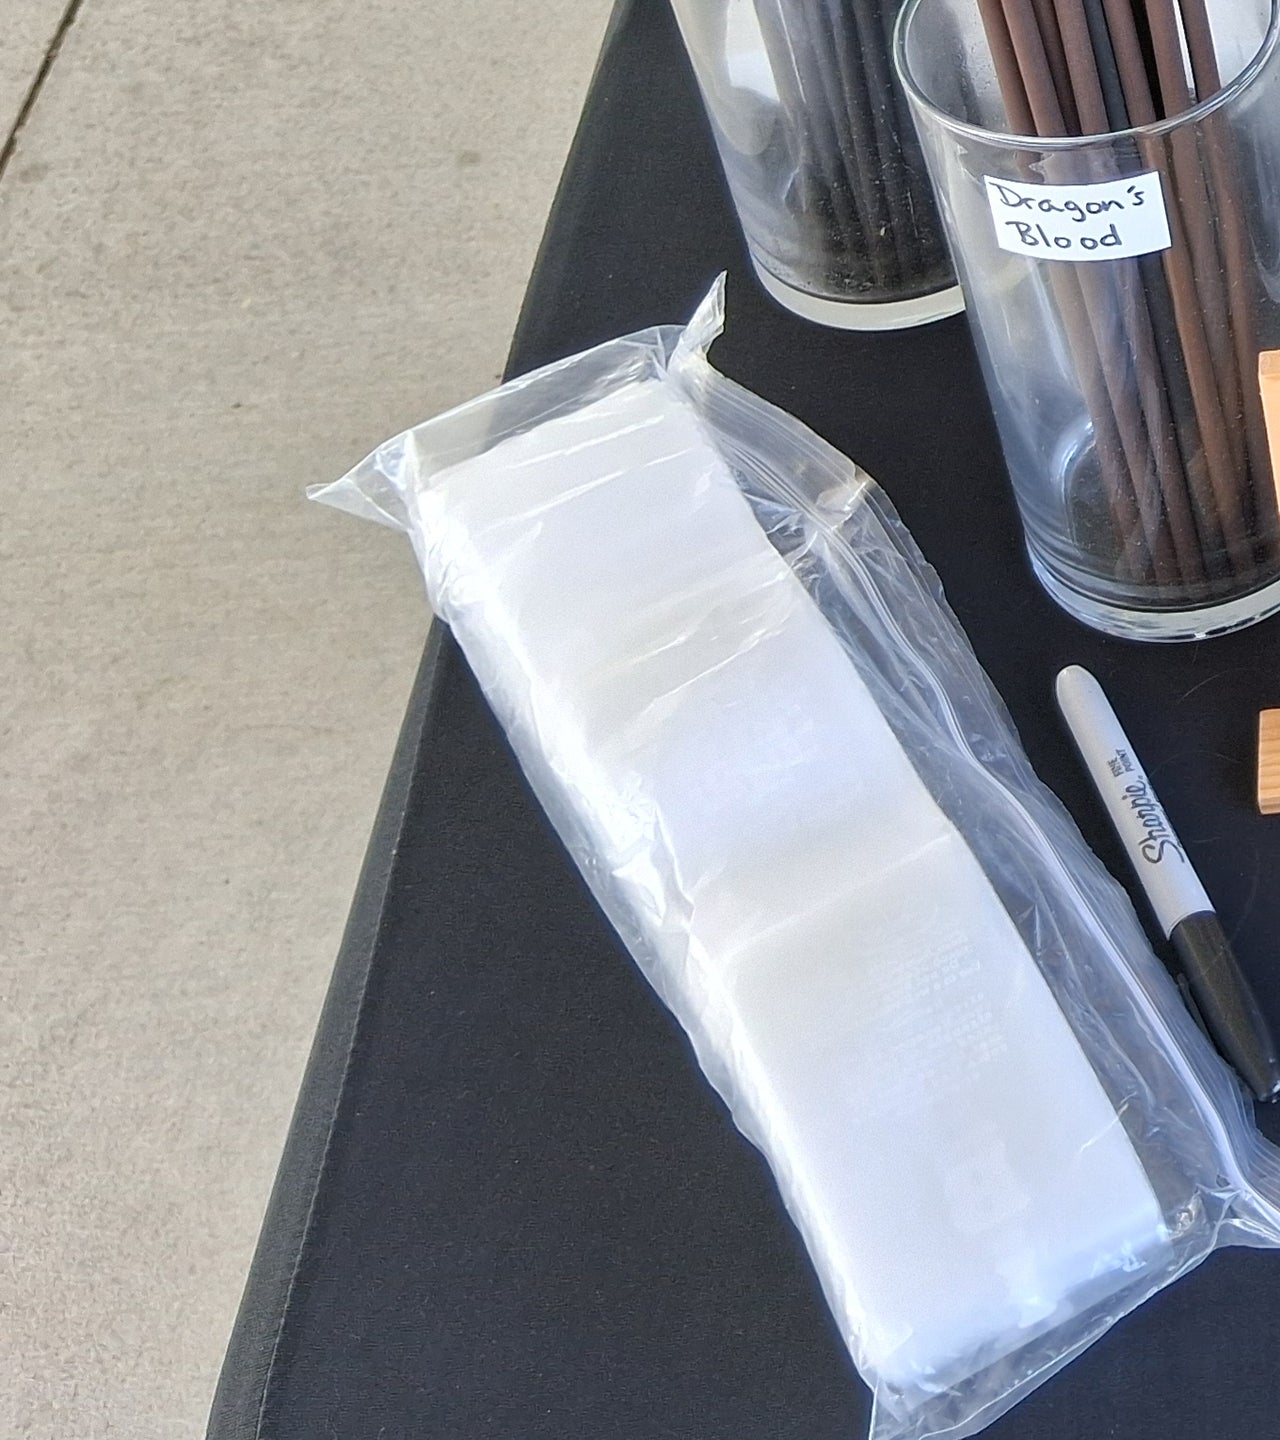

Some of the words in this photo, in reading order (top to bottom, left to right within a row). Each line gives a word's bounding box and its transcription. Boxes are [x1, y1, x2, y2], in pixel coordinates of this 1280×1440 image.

[988, 181, 1145, 223] Dragon's
[1004, 221, 1123, 251] Blood
[1106, 756, 1125, 778] FINE
[1115, 748, 1136, 773] POINT
[1122, 776, 1185, 864] Sharpie
